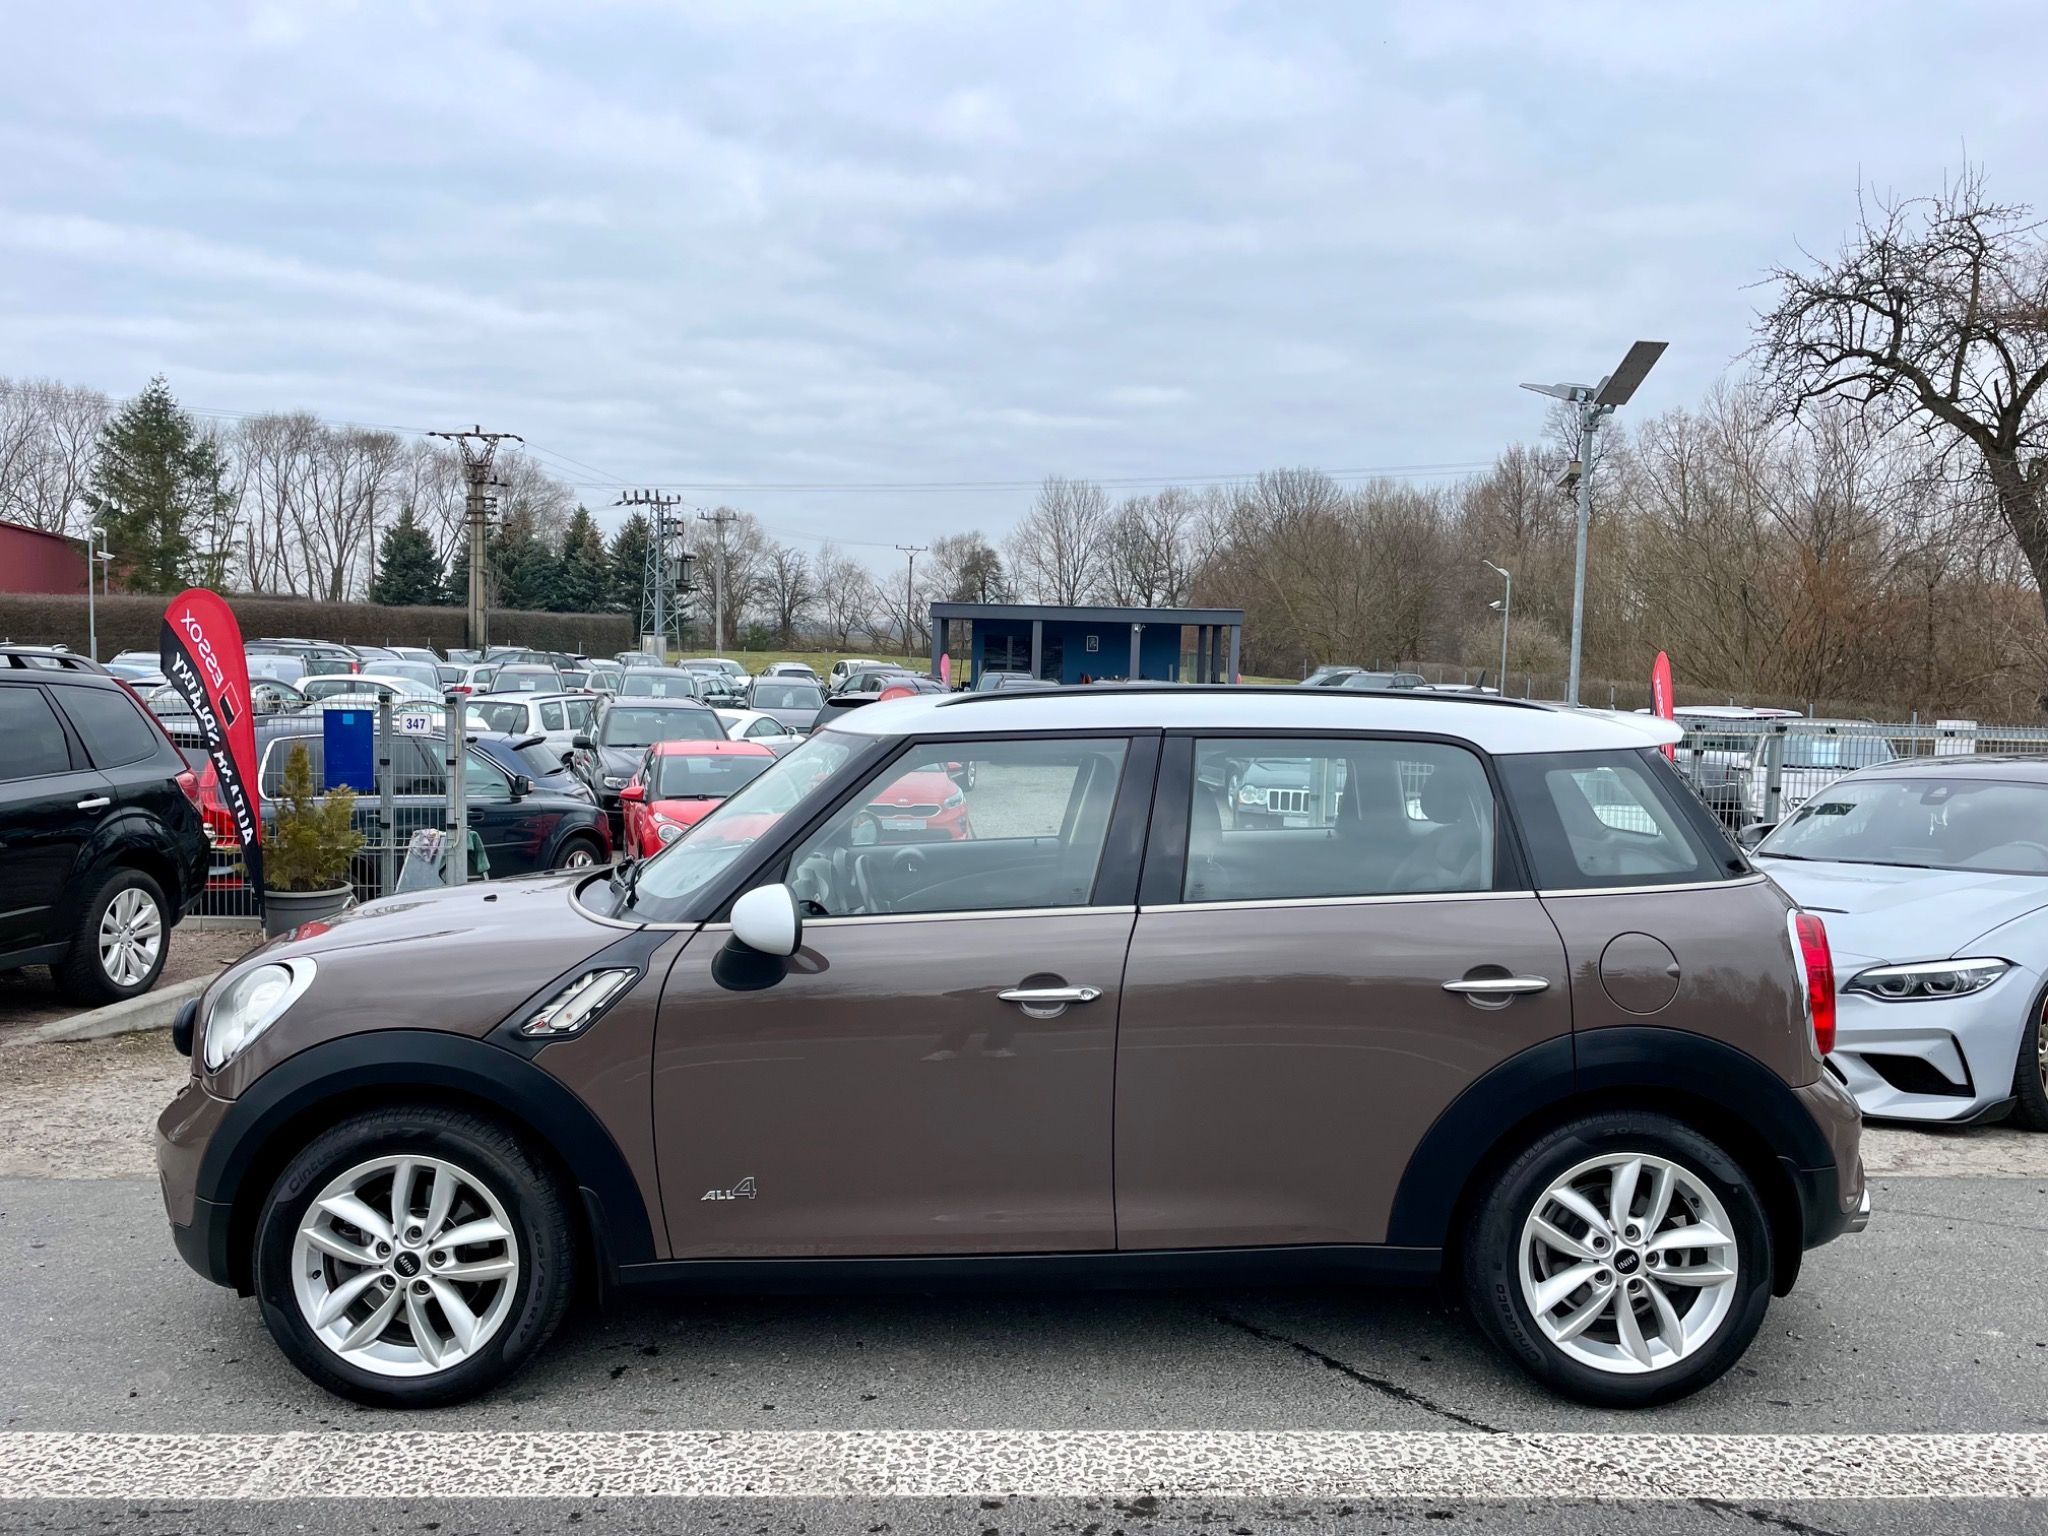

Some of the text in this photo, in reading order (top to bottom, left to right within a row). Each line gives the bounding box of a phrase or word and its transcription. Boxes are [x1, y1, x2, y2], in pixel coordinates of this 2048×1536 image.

[406, 717, 426, 730] 347
[700, 1176, 757, 1201] ALL4
[398, 1255, 416, 1275] MINI
[1617, 1253, 1637, 1270] MINI
